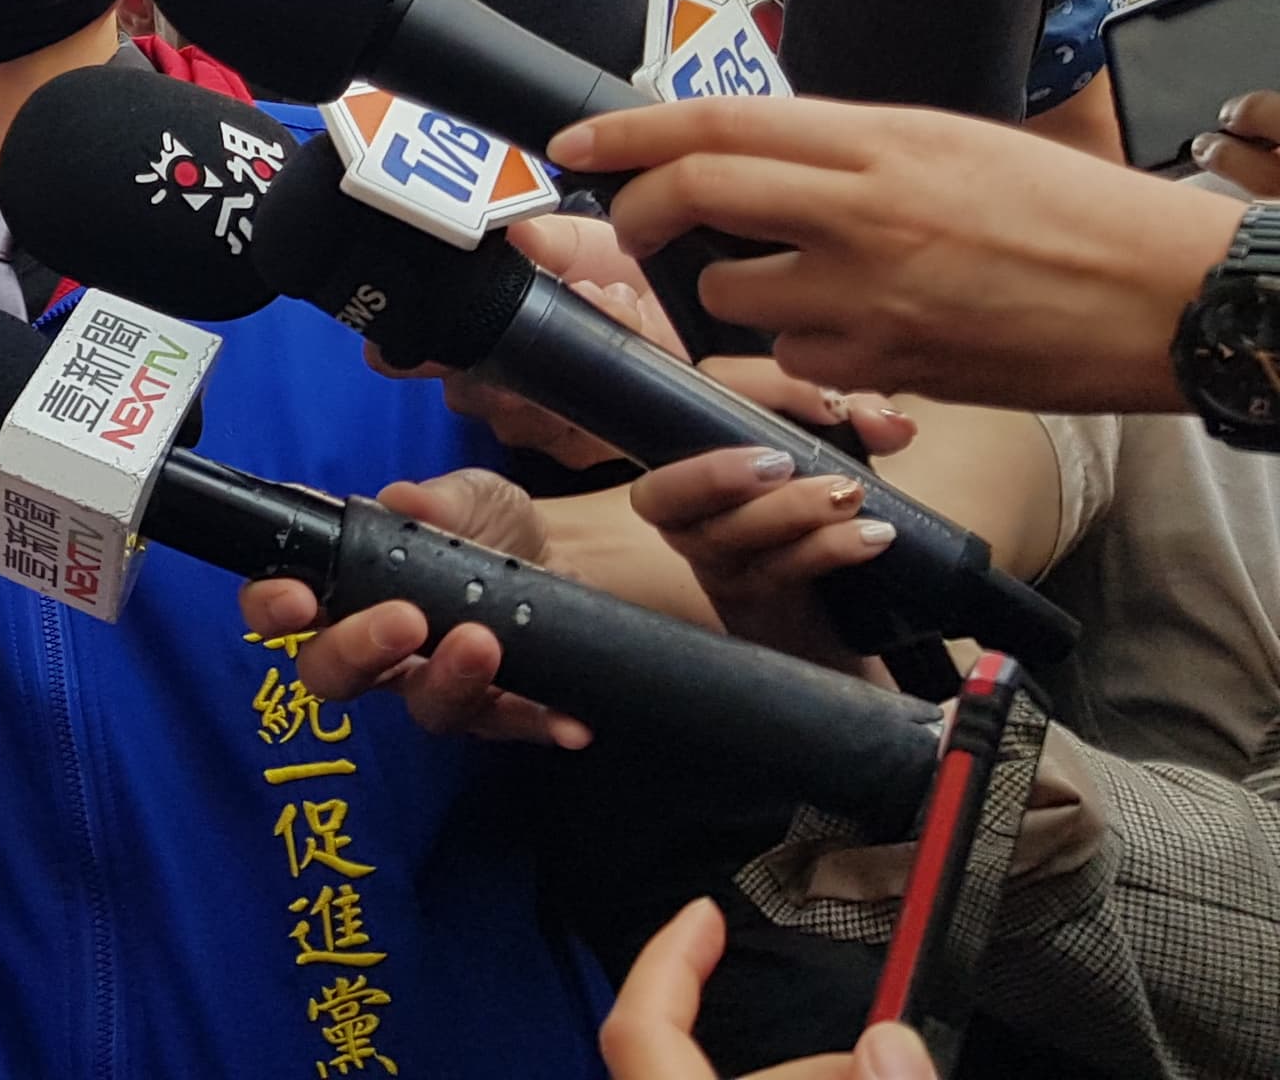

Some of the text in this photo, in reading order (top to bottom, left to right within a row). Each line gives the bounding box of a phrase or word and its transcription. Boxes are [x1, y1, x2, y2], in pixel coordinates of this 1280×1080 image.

[381, 111, 490, 203] TVB
[38, 309, 152, 433] 壹新聞
[2, 488, 61, 587] 壹新聞
[244, 631, 398, 1078] 統一促進黨
